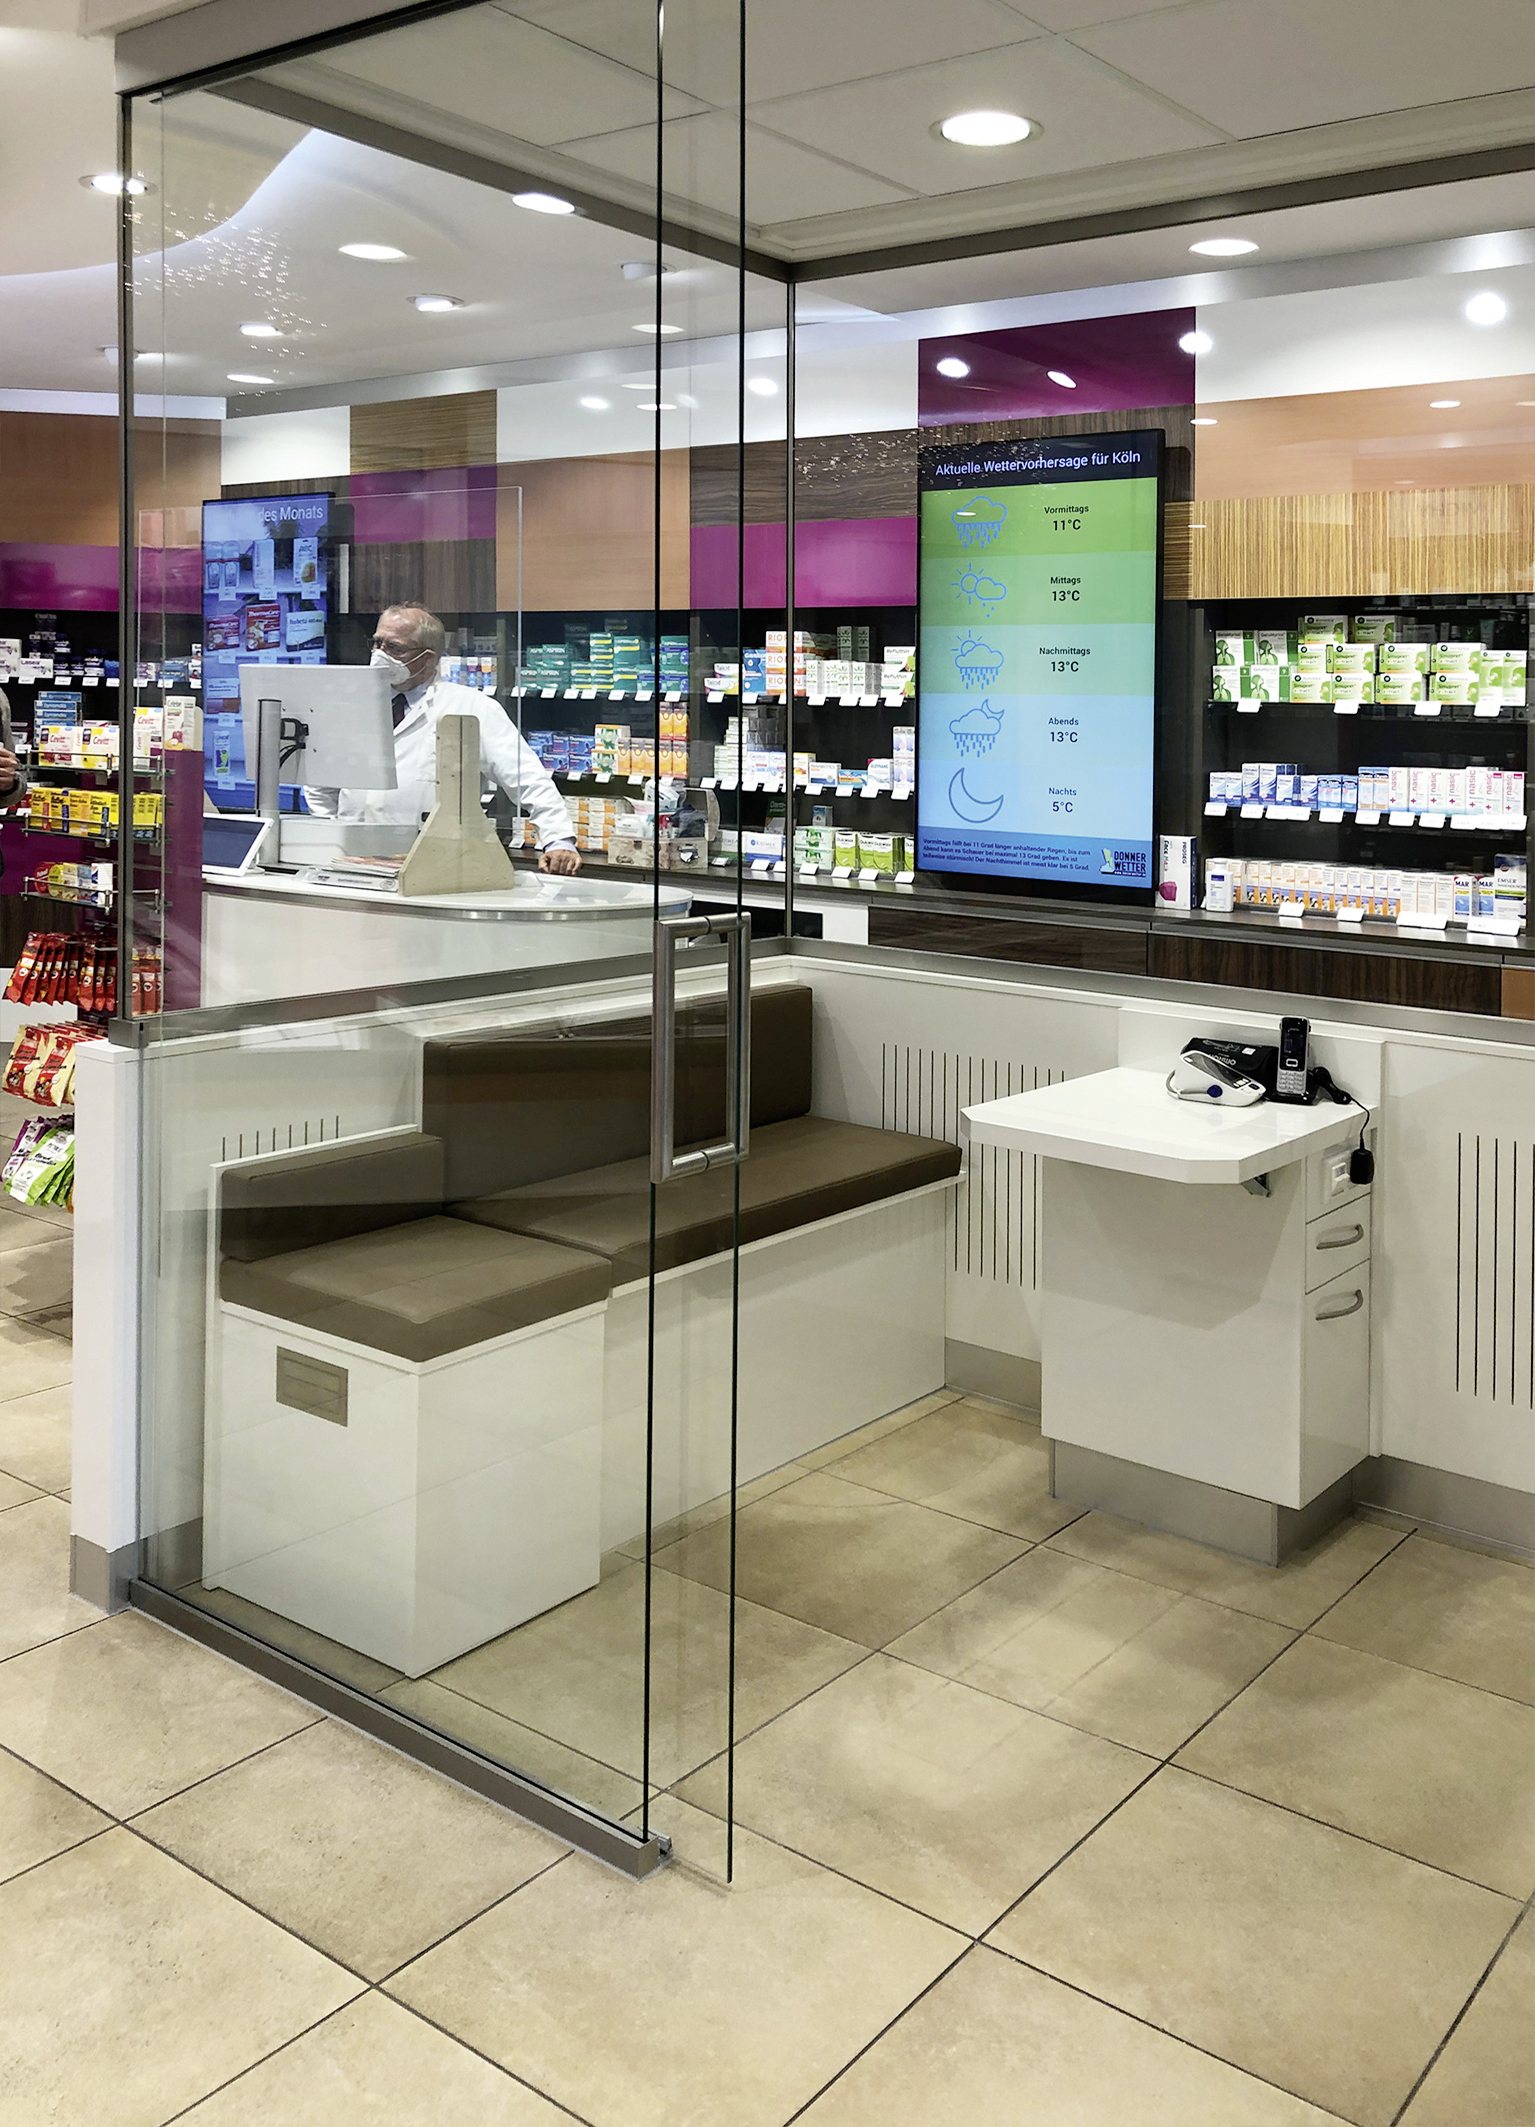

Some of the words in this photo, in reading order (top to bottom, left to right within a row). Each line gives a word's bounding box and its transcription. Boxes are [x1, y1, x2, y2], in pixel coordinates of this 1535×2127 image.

[935, 460, 981, 477] Aktuelle
[983, 453, 1088, 473] Wettervorhersage
[1091, 453, 1109, 466] für
[1112, 450, 1141, 465] Köln
[279, 505, 324, 521] Monats
[1044, 505, 1090, 514] Vormittags
[1053, 518, 1082, 531] 11°C
[1050, 575, 1081, 586] Mittags
[1052, 590, 1081, 602] 13°C
[1039, 646, 1091, 657] Nachmittags
[1051, 661, 1079, 673] 13°C
[1048, 717, 1079, 726] Abends
[1050, 731, 1078, 743] 13°C
[1448, 772, 1456, 794] nasic
[1469, 770, 1477, 795] nasic
[1485, 773, 1493, 795] nasic
[1505, 774, 1513, 796] nasic
[1048, 787, 1077, 796] Nachts
[1052, 801, 1074, 813] 5°C
[923, 838, 951, 847] Vormittags
[1013, 844, 1046, 853] anhaltender
[985, 857, 1022, 866] Nachthimmel
[1113, 850, 1147, 863] DONNER
[1114, 861, 1147, 872] WETTER
